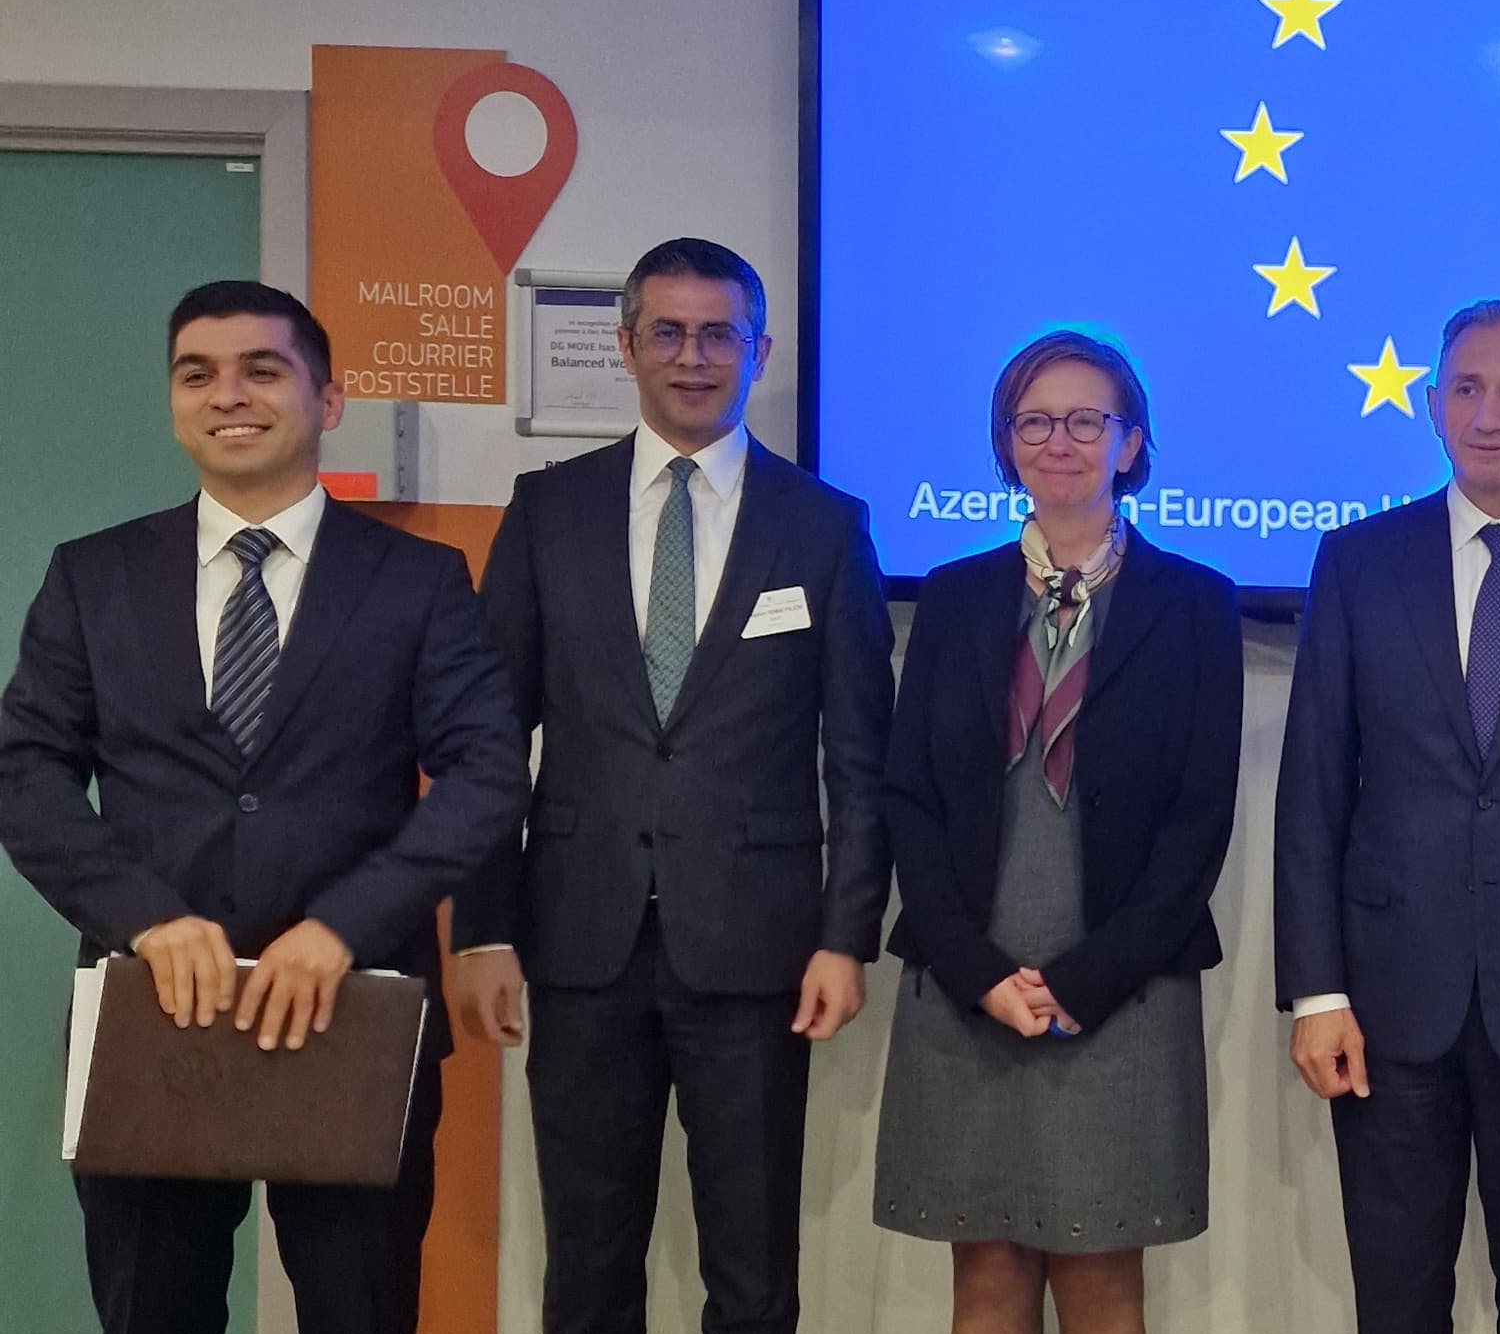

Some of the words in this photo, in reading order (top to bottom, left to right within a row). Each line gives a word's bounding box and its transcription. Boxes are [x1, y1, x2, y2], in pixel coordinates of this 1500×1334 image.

[359, 281, 494, 309] MAILROOM
[419, 313, 494, 339] SALLE
[373, 341, 494, 368] COURRIER
[550, 341, 565, 351] DG
[567, 342, 597, 352] MOVE
[551, 356, 605, 368] Balanced
[344, 370, 494, 398] POSTSTELLE
